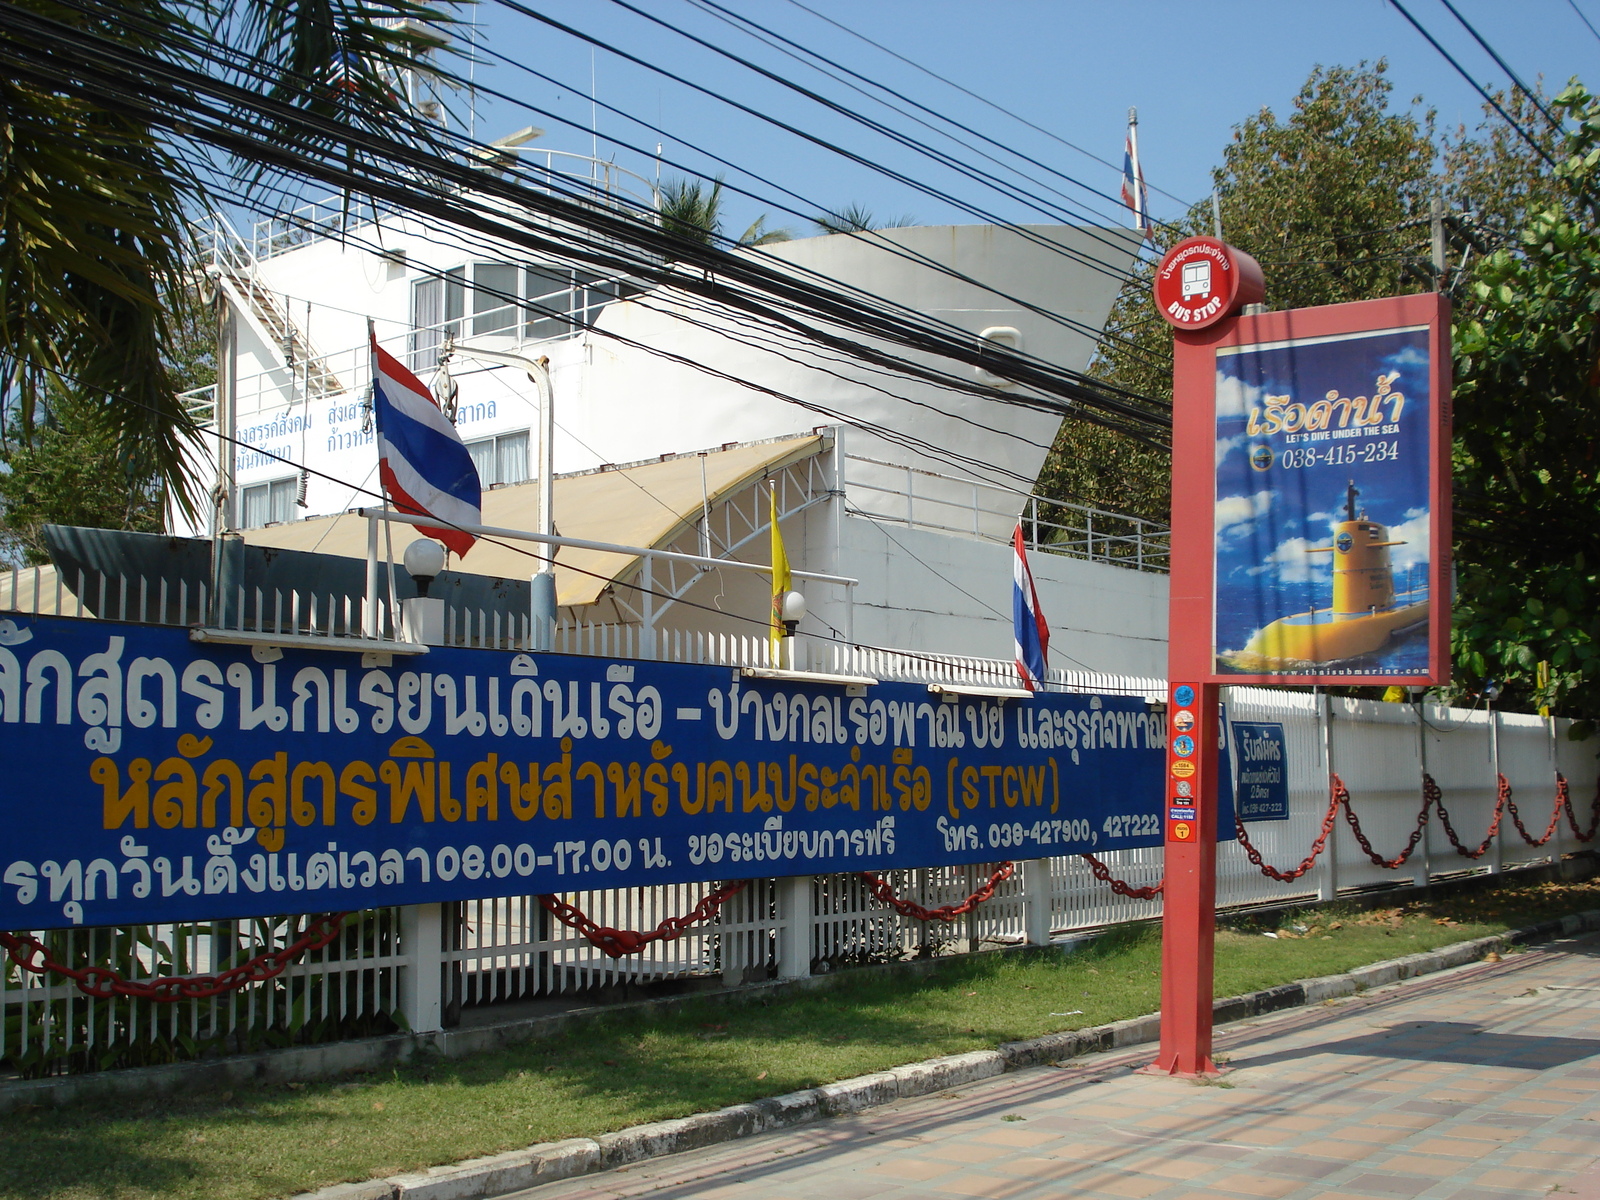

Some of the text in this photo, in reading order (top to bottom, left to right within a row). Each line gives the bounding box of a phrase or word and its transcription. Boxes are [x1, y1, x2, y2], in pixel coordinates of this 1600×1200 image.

[1168, 296, 1222, 322] BUS STOP
[1246, 371, 1405, 436] เรือดำน้ำ
[1286, 424, 1400, 444] LET'S DIVE UNDER THE SEA
[1282, 441, 1399, 469] 038-415-234
[1272, 667, 1429, 676] www.thaisubmarine.com
[947, 757, 1059, 819] (STCW)
[688, 815, 895, 865] ขอระเบียบการฟรี
[936, 815, 984, 852] โทร.
[1103, 814, 1160, 839] 427222
